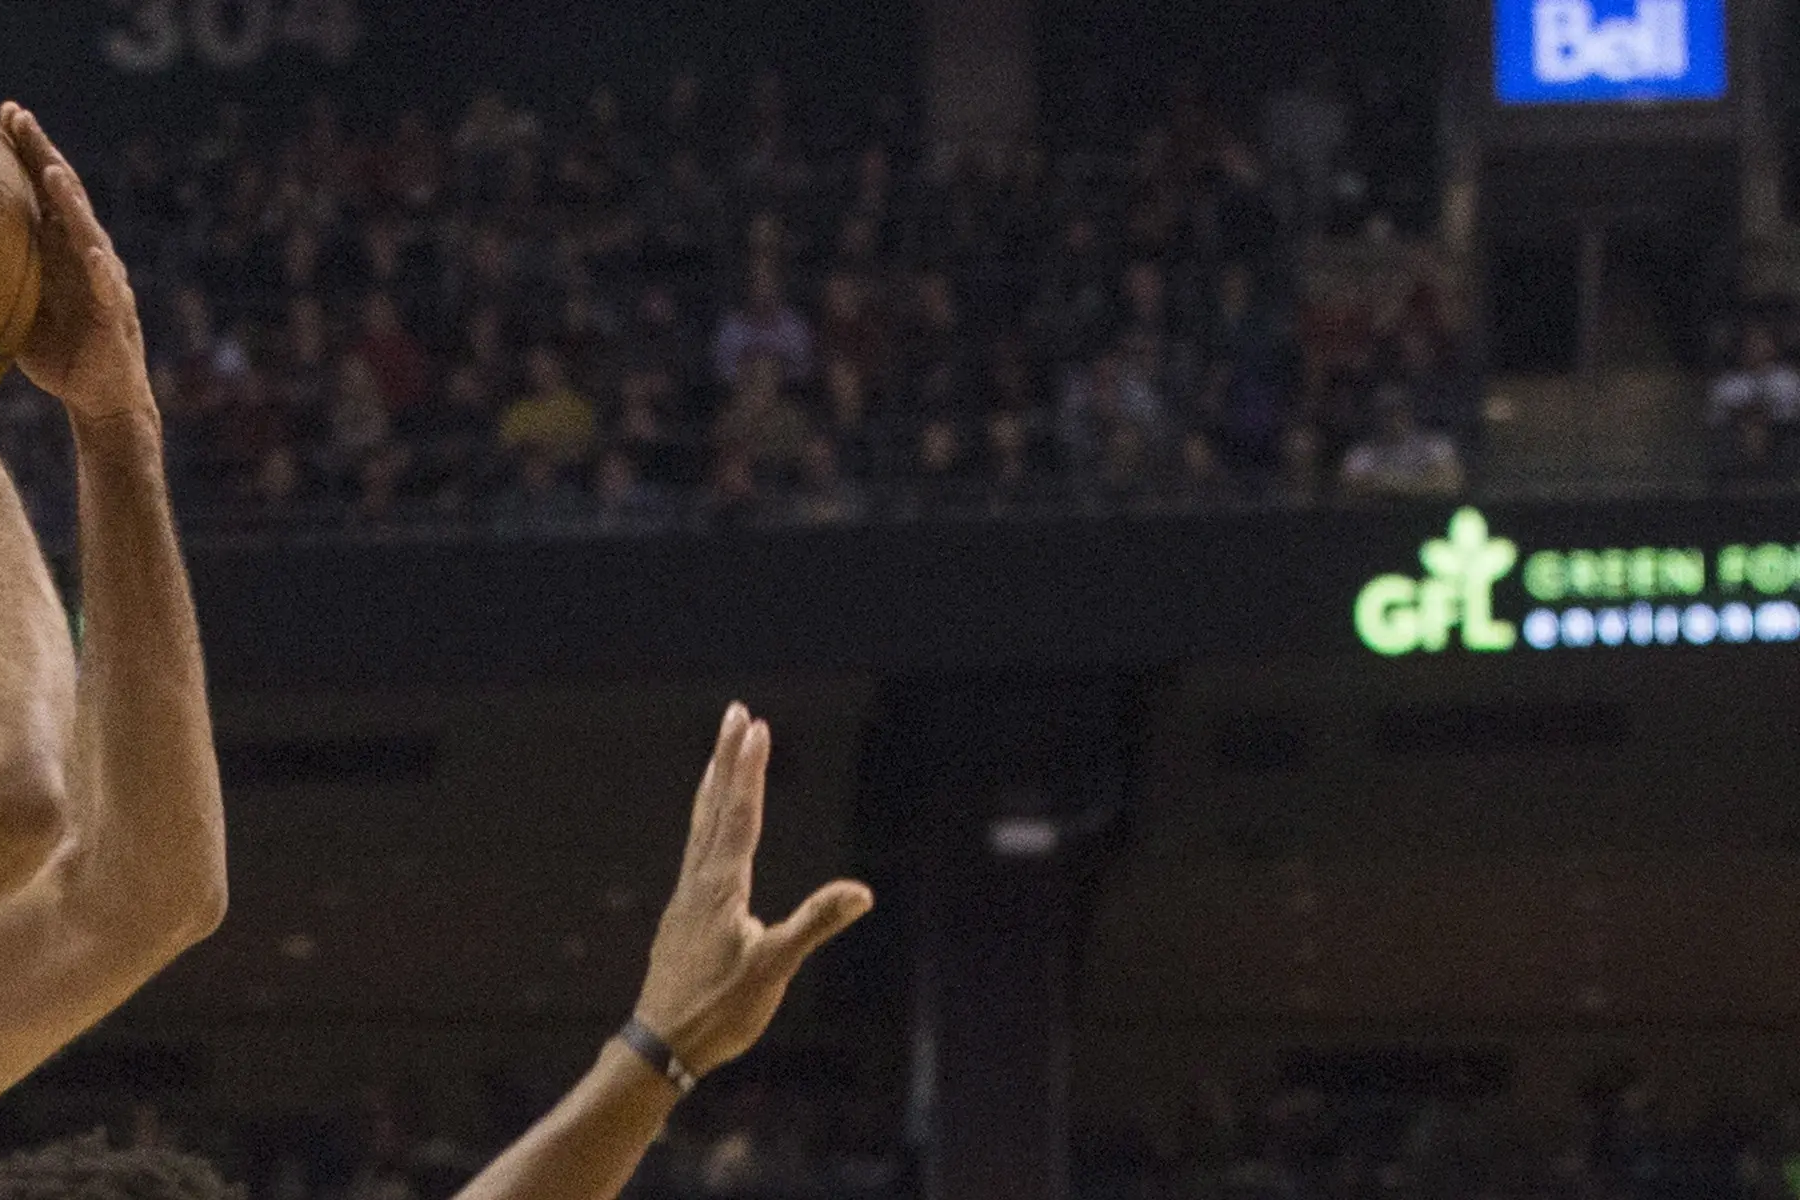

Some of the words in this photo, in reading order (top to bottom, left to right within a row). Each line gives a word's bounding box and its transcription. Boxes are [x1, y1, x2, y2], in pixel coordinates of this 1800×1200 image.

[1533, 0, 1688, 82] Bell
[1354, 528, 1518, 656] GFL
[1523, 547, 1705, 601] GREEN
[1717, 544, 1800, 595] FO
